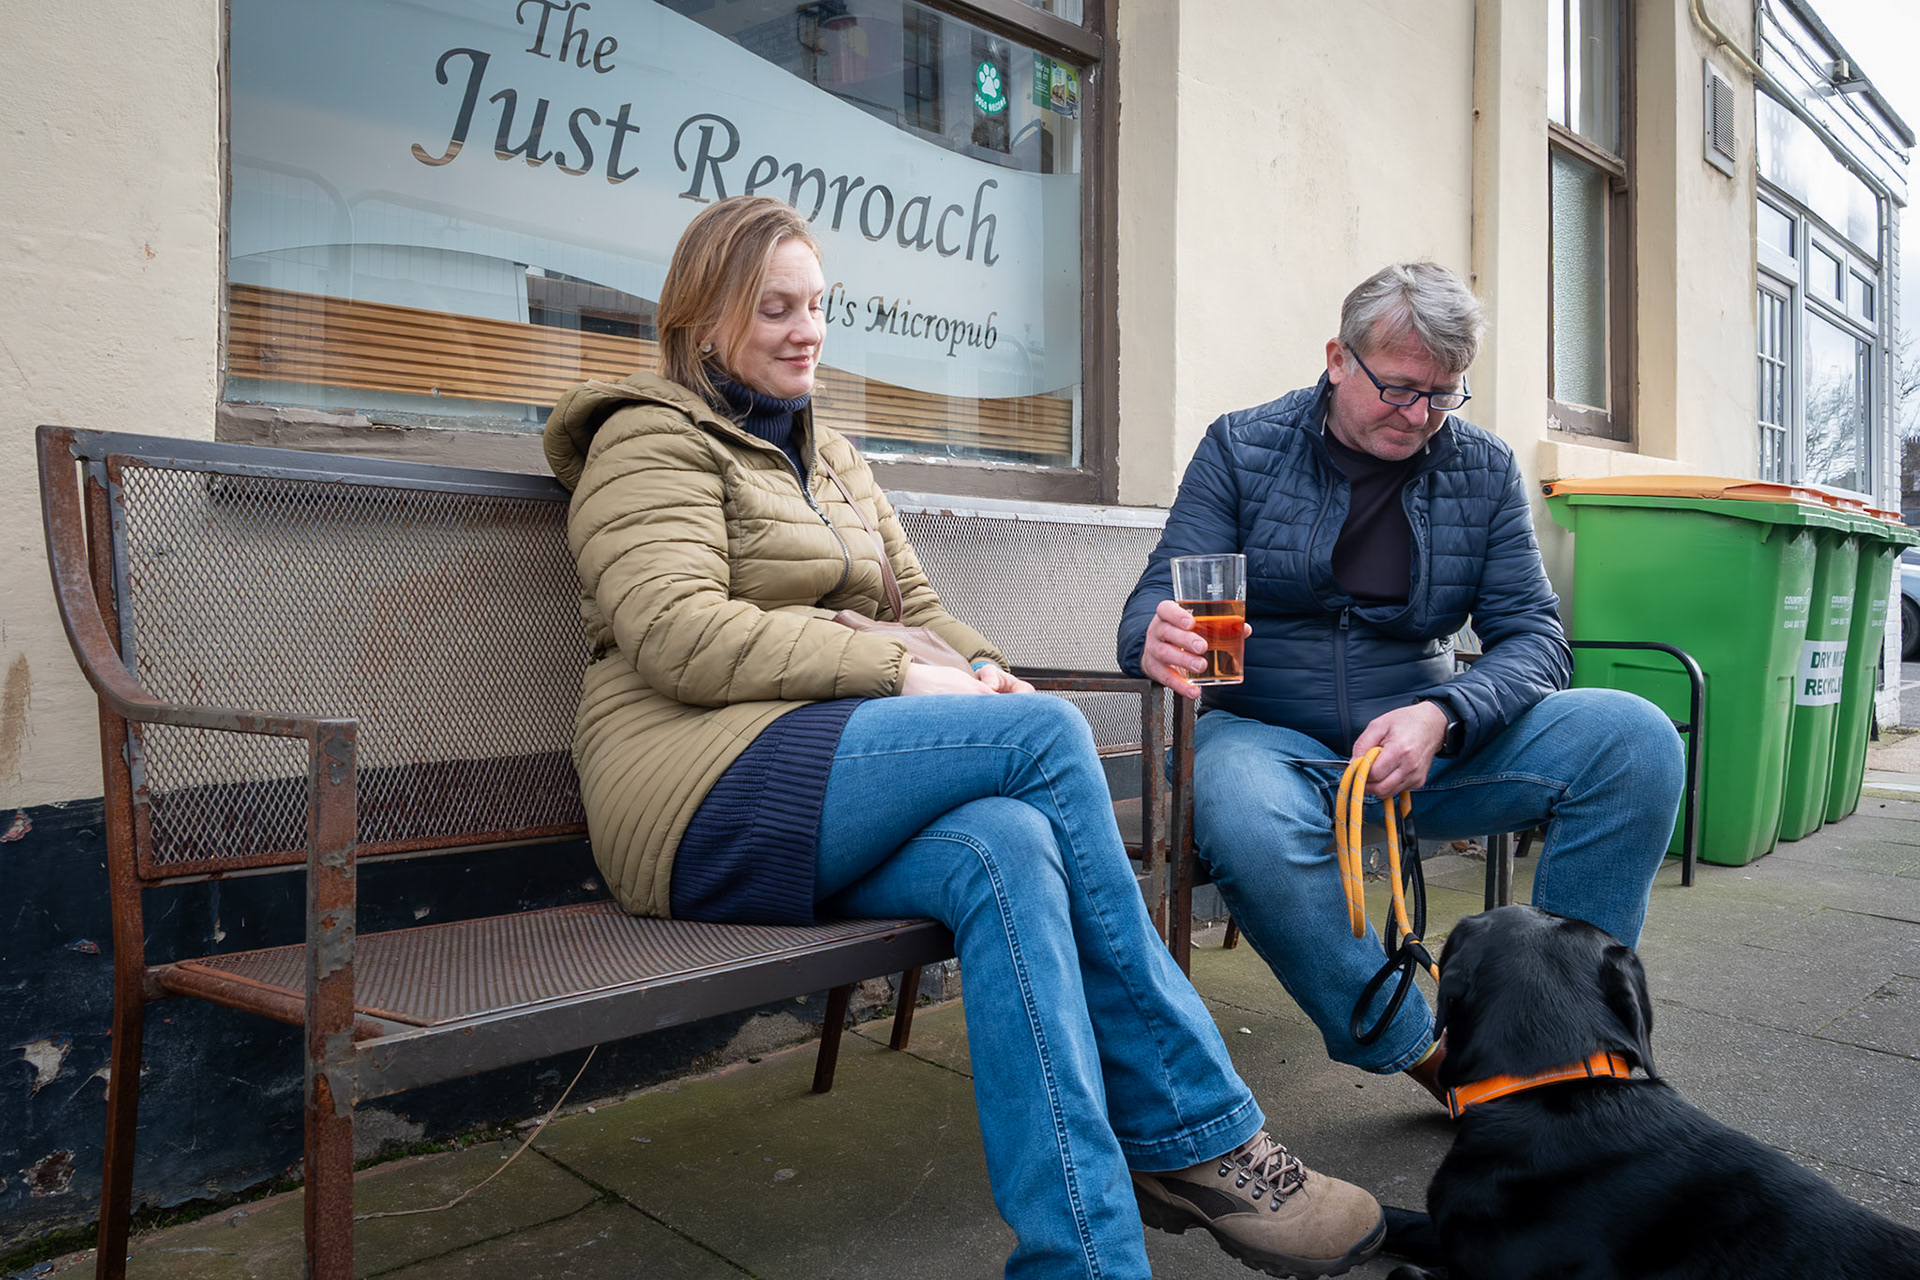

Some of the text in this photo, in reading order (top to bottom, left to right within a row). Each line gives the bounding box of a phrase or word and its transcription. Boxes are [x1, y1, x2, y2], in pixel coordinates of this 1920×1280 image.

[516, 0, 618, 74] The
[411, 48, 640, 185] Just
[975, 93, 1007, 112] DOGS WELCOME
[864, 295, 999, 357] Micropub
[1810, 651, 1831, 668] DRY
